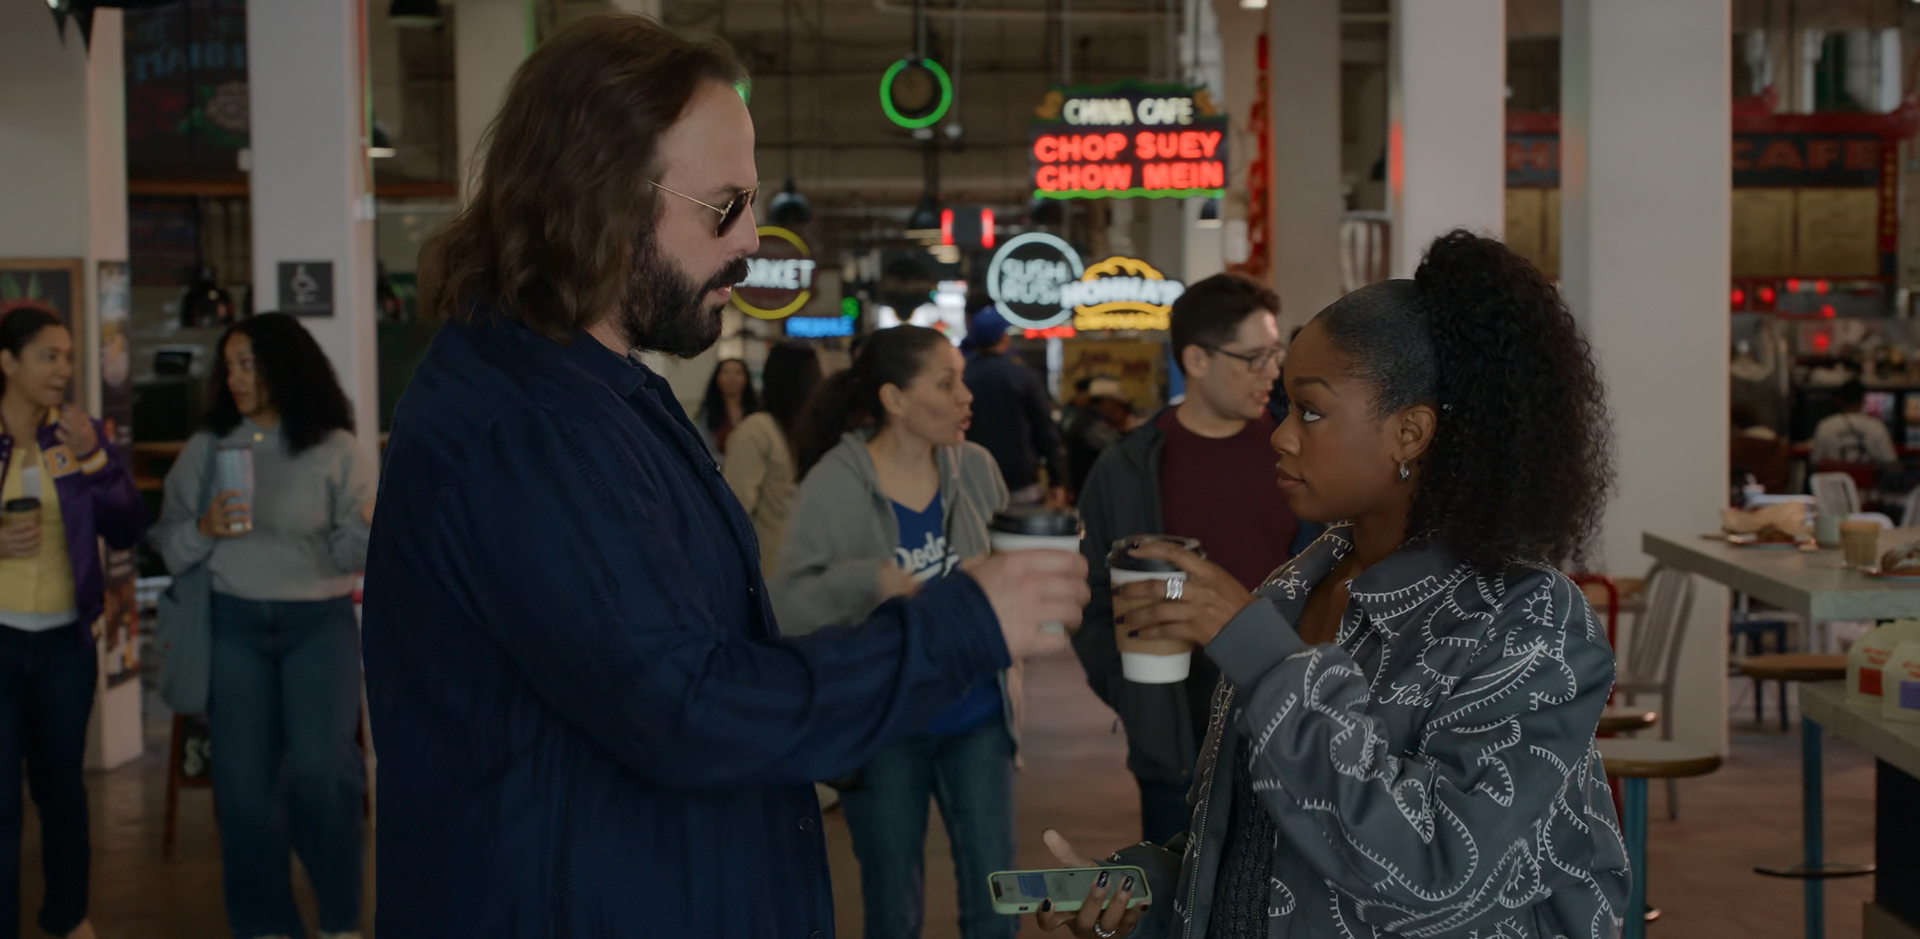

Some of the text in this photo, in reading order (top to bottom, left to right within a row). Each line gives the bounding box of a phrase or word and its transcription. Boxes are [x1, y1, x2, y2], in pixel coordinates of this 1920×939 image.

[1063, 97, 1193, 125] CHINA CAFE
[1034, 131, 1222, 162] CHOP SUEY
[1036, 161, 1225, 191] CHOW MEIN
